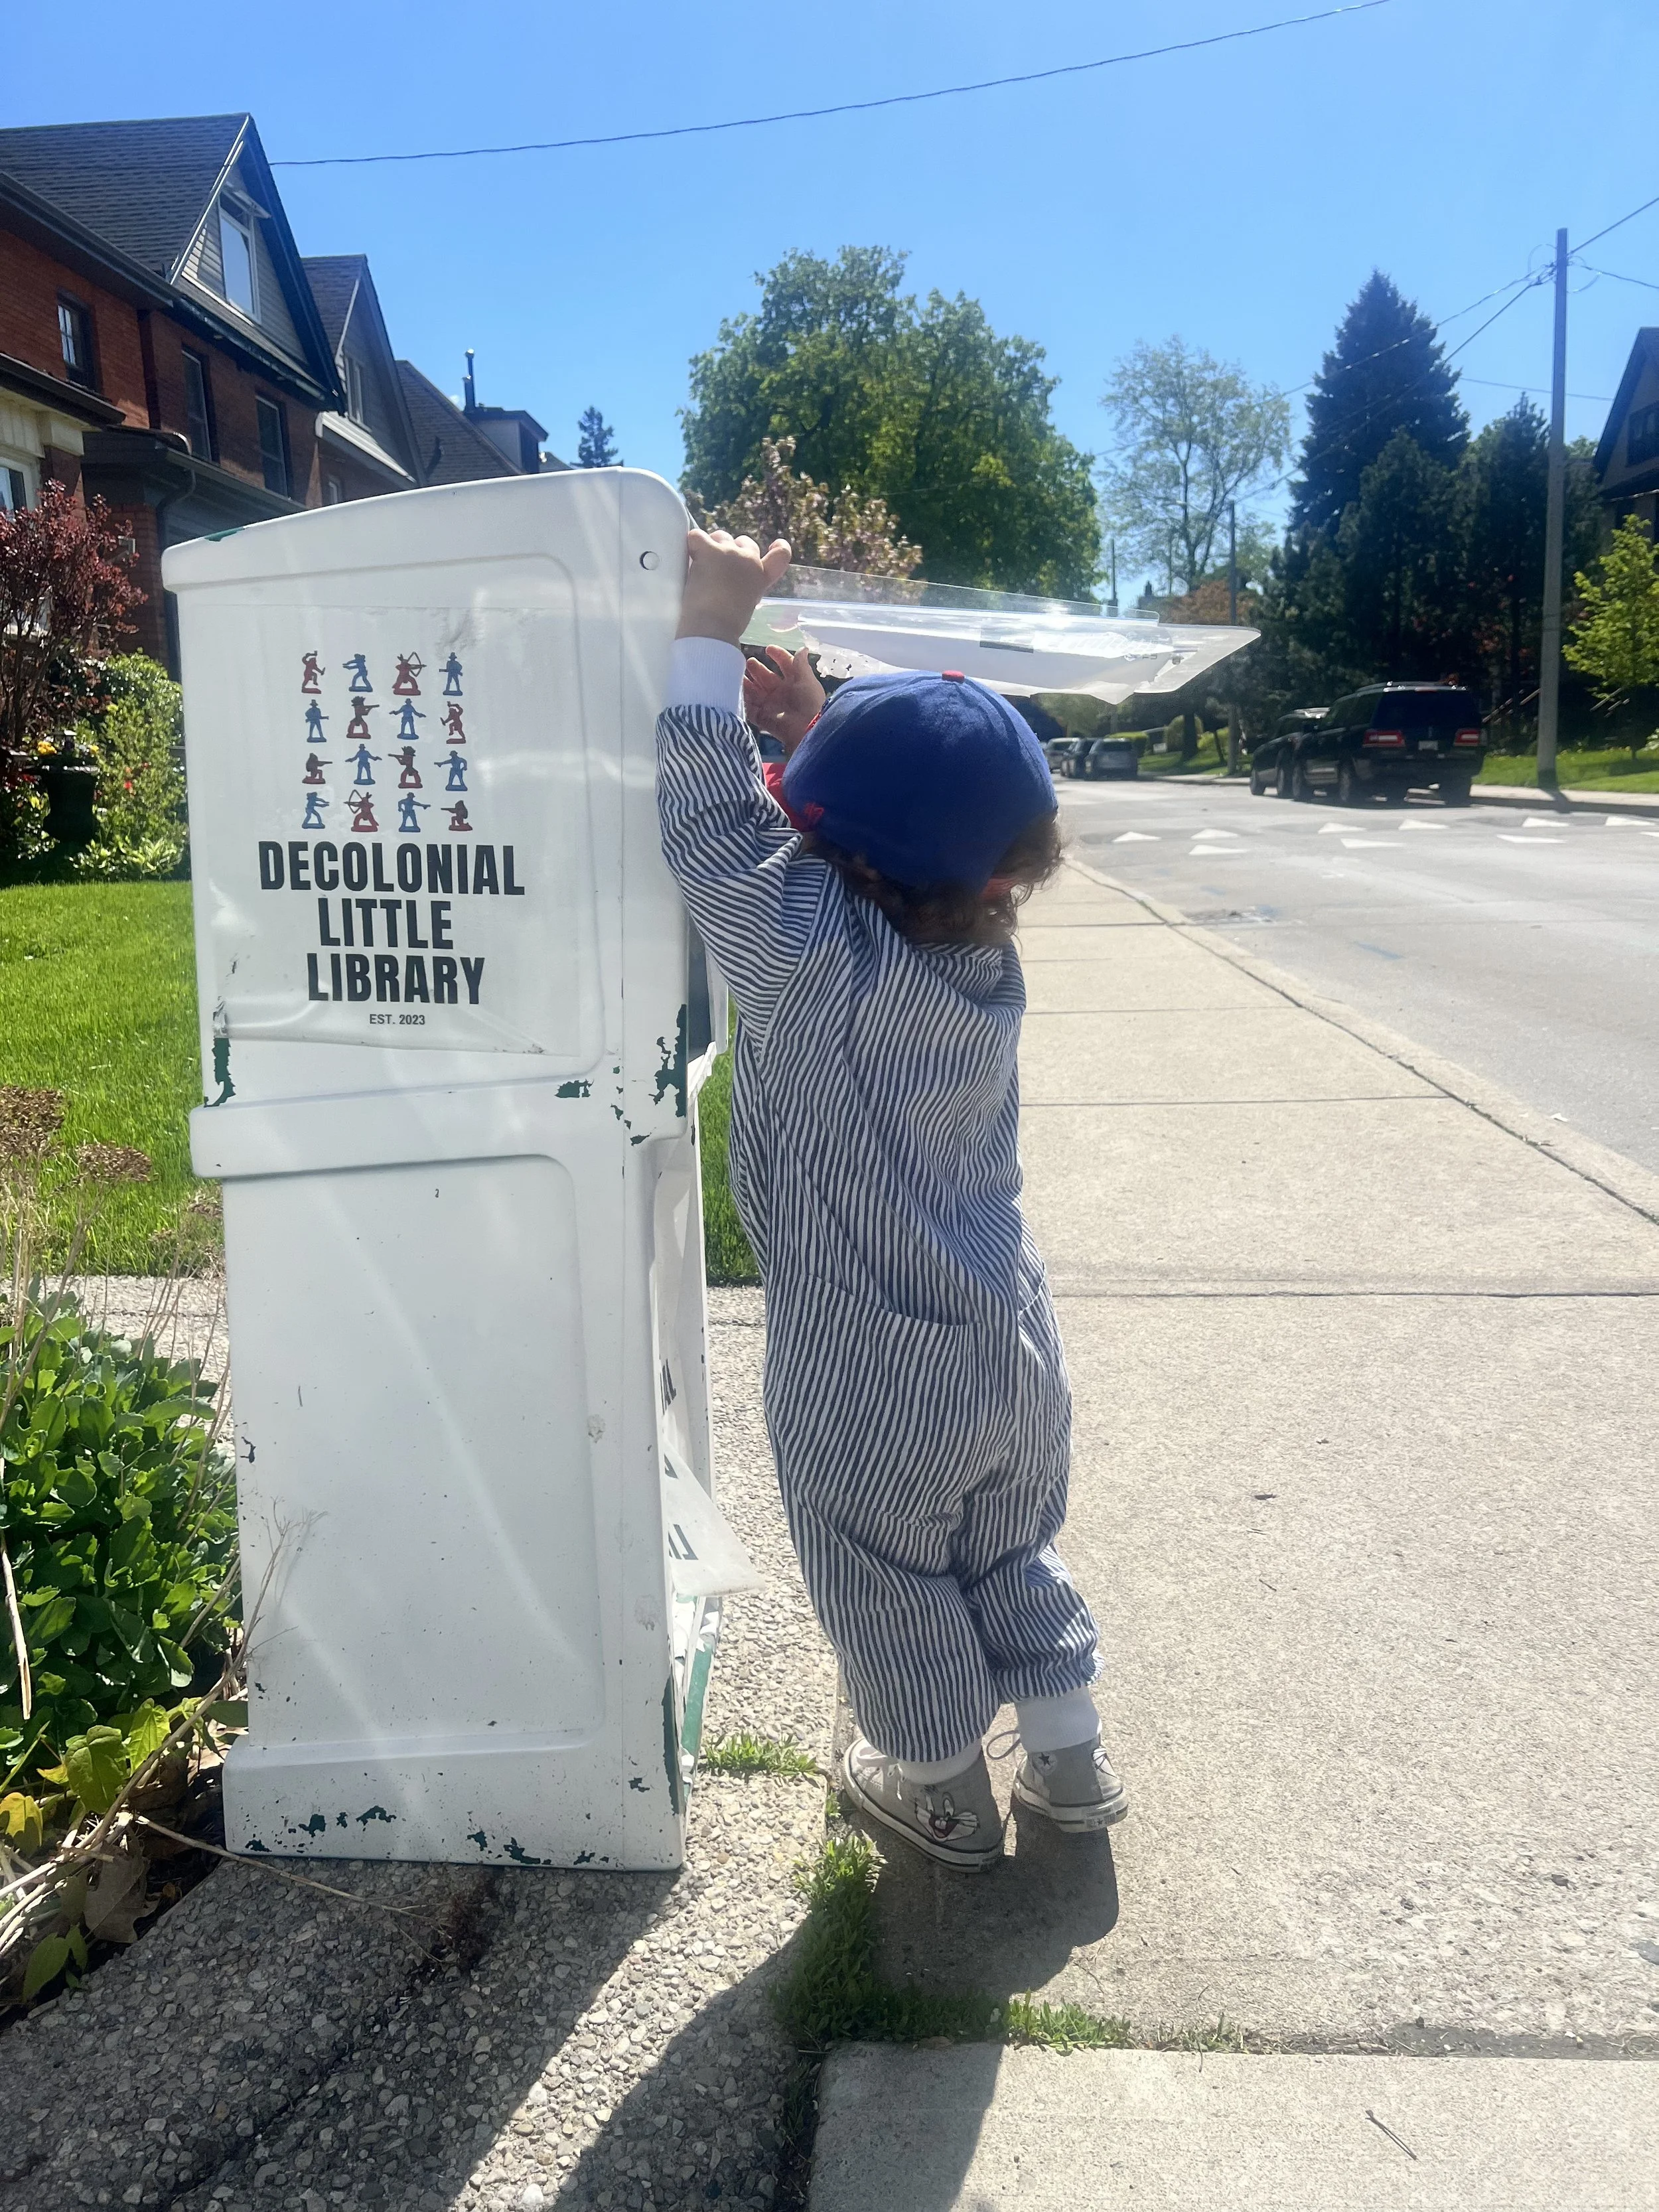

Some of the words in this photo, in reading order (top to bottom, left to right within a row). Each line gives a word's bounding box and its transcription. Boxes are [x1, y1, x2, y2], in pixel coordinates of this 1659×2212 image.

[258, 841, 525, 895] DECOLONIAL
[318, 897, 454, 950] LITTLE
[307, 952, 485, 1005] LIBRARY
[369, 1013, 396, 1025] EST.
[399, 1014, 425, 1025] 2023
